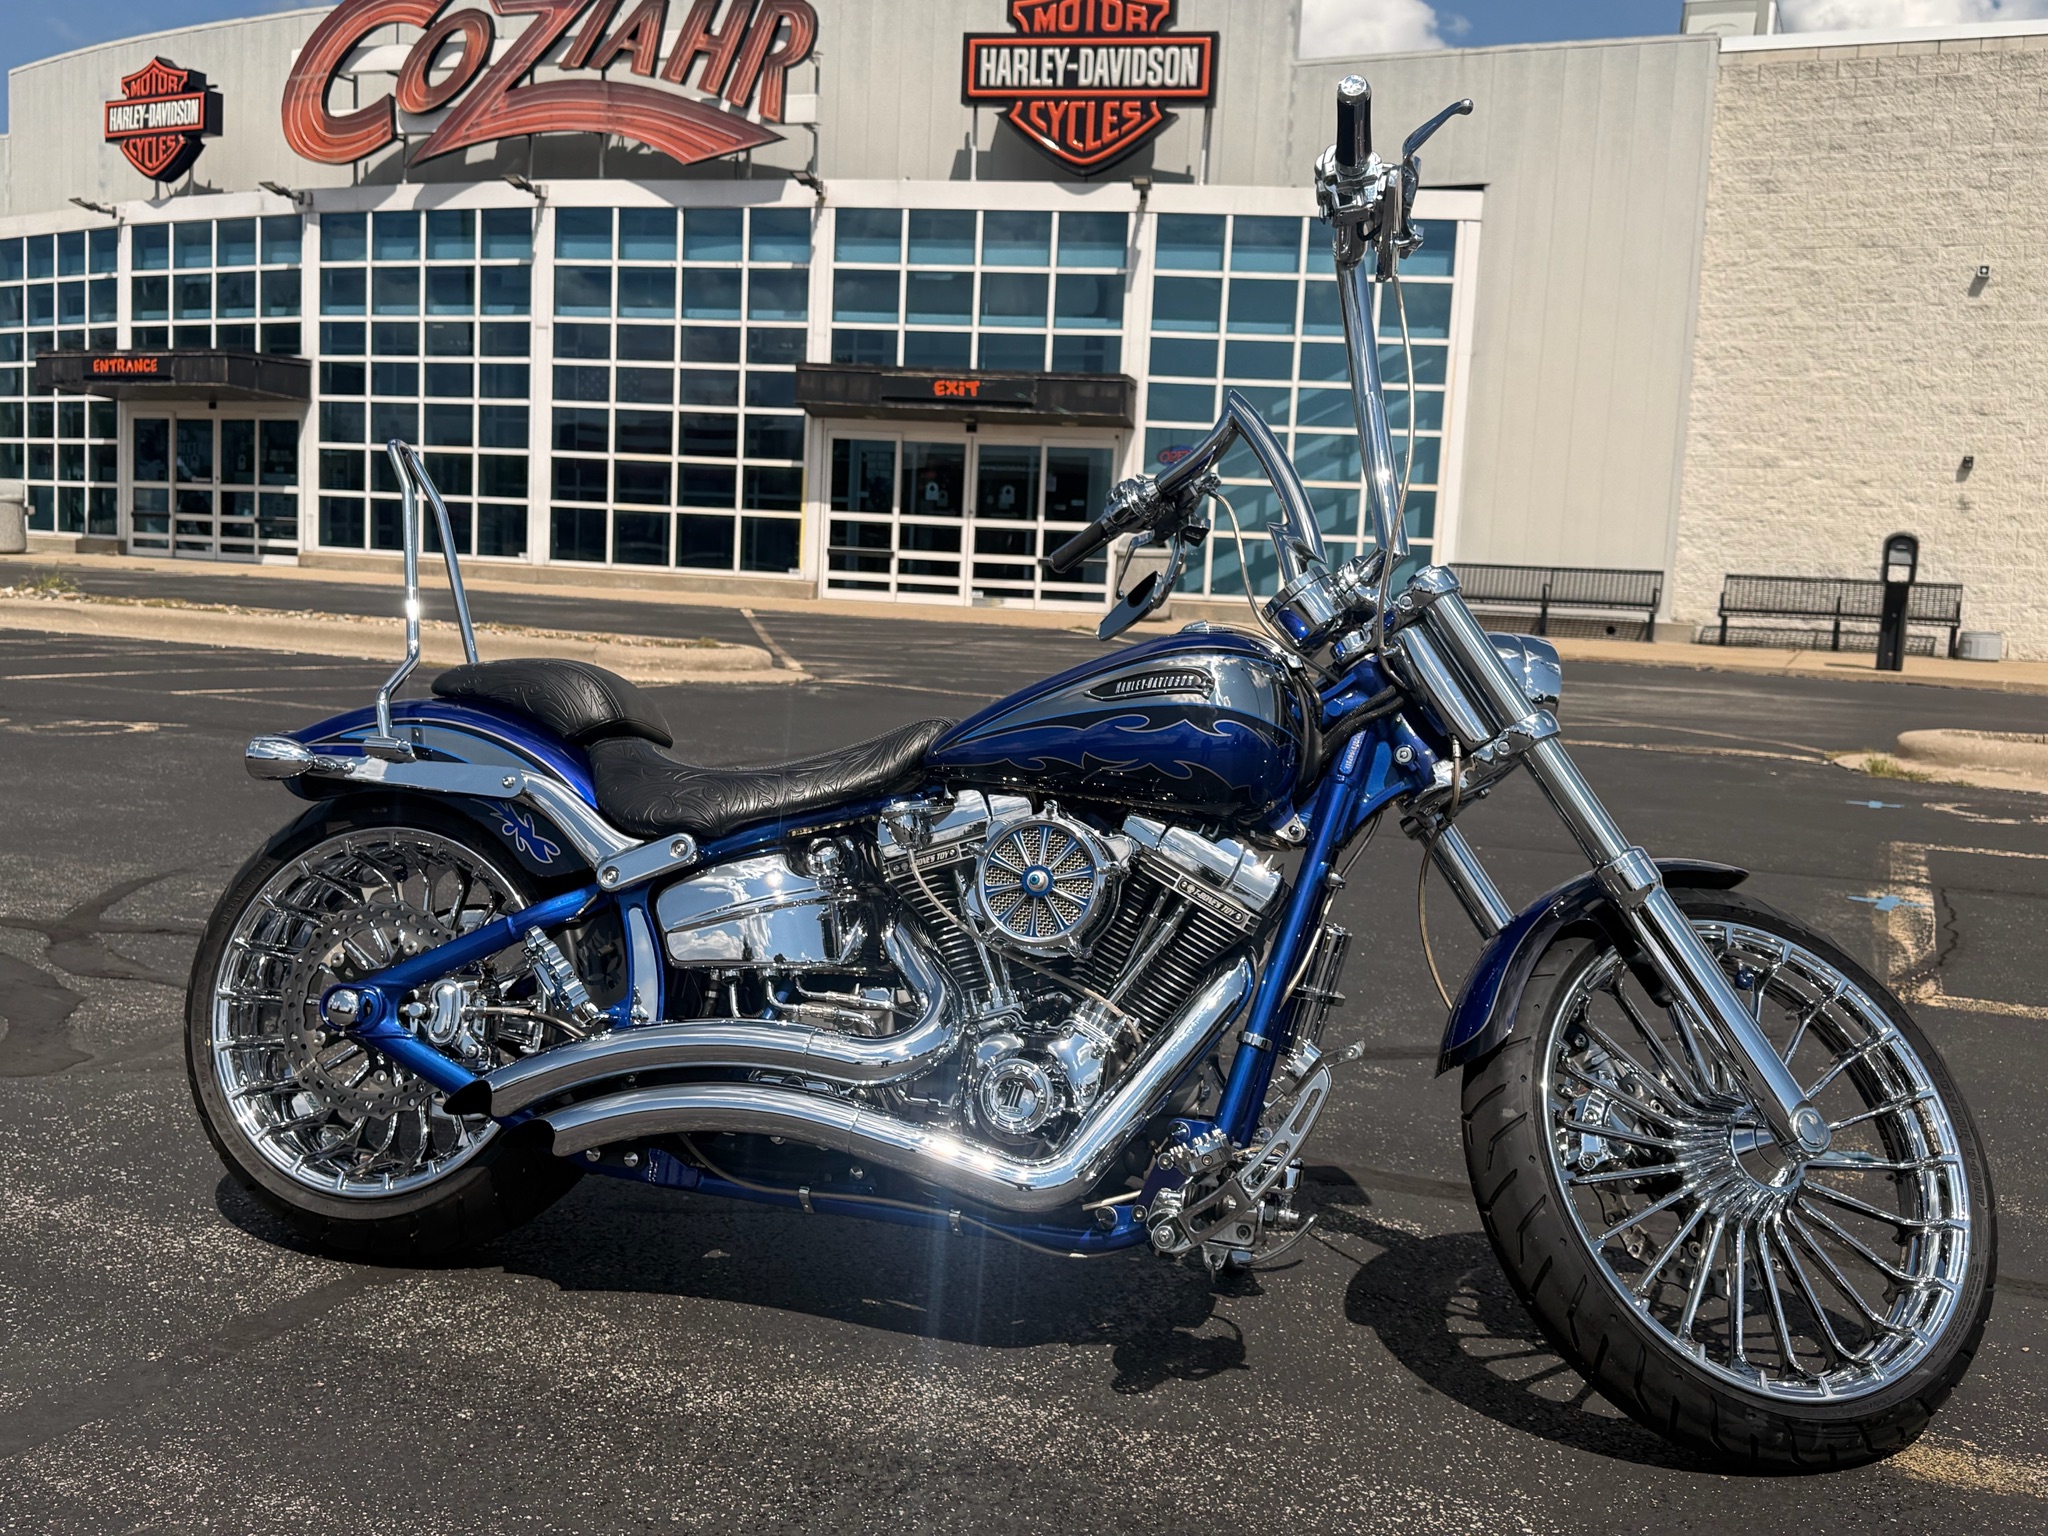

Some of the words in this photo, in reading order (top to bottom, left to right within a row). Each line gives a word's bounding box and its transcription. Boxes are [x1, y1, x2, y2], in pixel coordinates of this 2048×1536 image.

[1033, 0, 1149, 32] MOTOR
[130, 68, 178, 97] MOTOR
[979, 46, 1199, 87] HARLEY-DAVIDSON
[109, 98, 199, 132] HARLEY-DAVIDSON
[1029, 100, 1142, 152] CYCLES
[128, 135, 176, 169] CYCLES
[93, 358, 157, 373] ENTRANCE
[1159, 449, 1193, 463] OPE
[1115, 675, 1195, 694] HARLEY-DAVIDSON
[1221, 903, 1237, 917] TOY
[1933, 1064, 1972, 1143] DUNLOP
